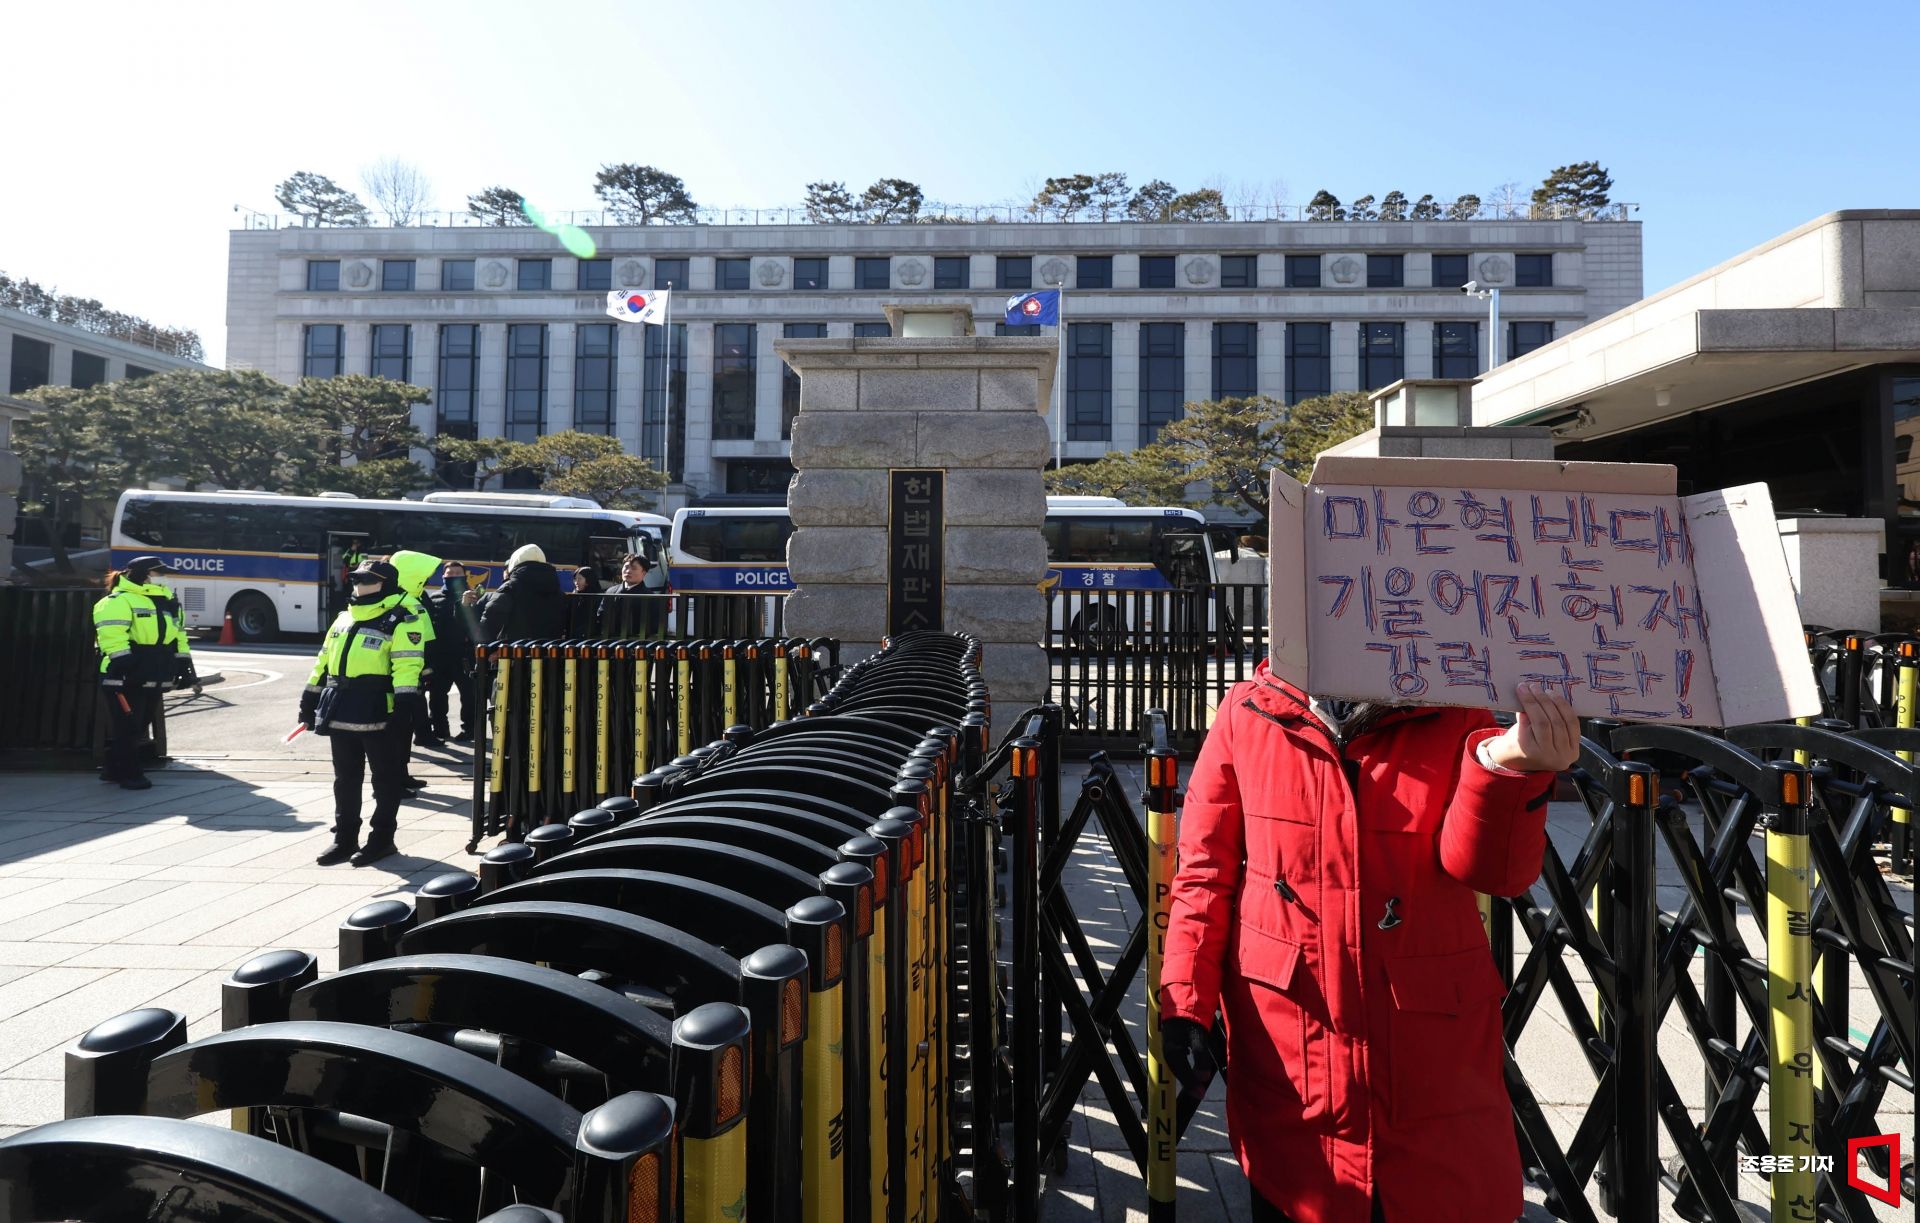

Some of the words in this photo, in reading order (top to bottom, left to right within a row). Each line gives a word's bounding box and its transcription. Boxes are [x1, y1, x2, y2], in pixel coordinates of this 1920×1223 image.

[1322, 485, 1523, 566] 마은혁
[1530, 491, 1695, 571] 반대
[173, 557, 225, 571] POLICE
[735, 572, 787, 585] POLICE
[1318, 565, 1555, 645] 기울어진
[1551, 571, 1710, 650] 헌재
[1363, 636, 1499, 704] 강력
[1516, 648, 1696, 720] 규탄!
[529, 682, 537, 734] POLICE
[677, 684, 685, 737] POLICE
[528, 743, 536, 778] LINE
[1157, 1063, 1172, 1162] LINE
